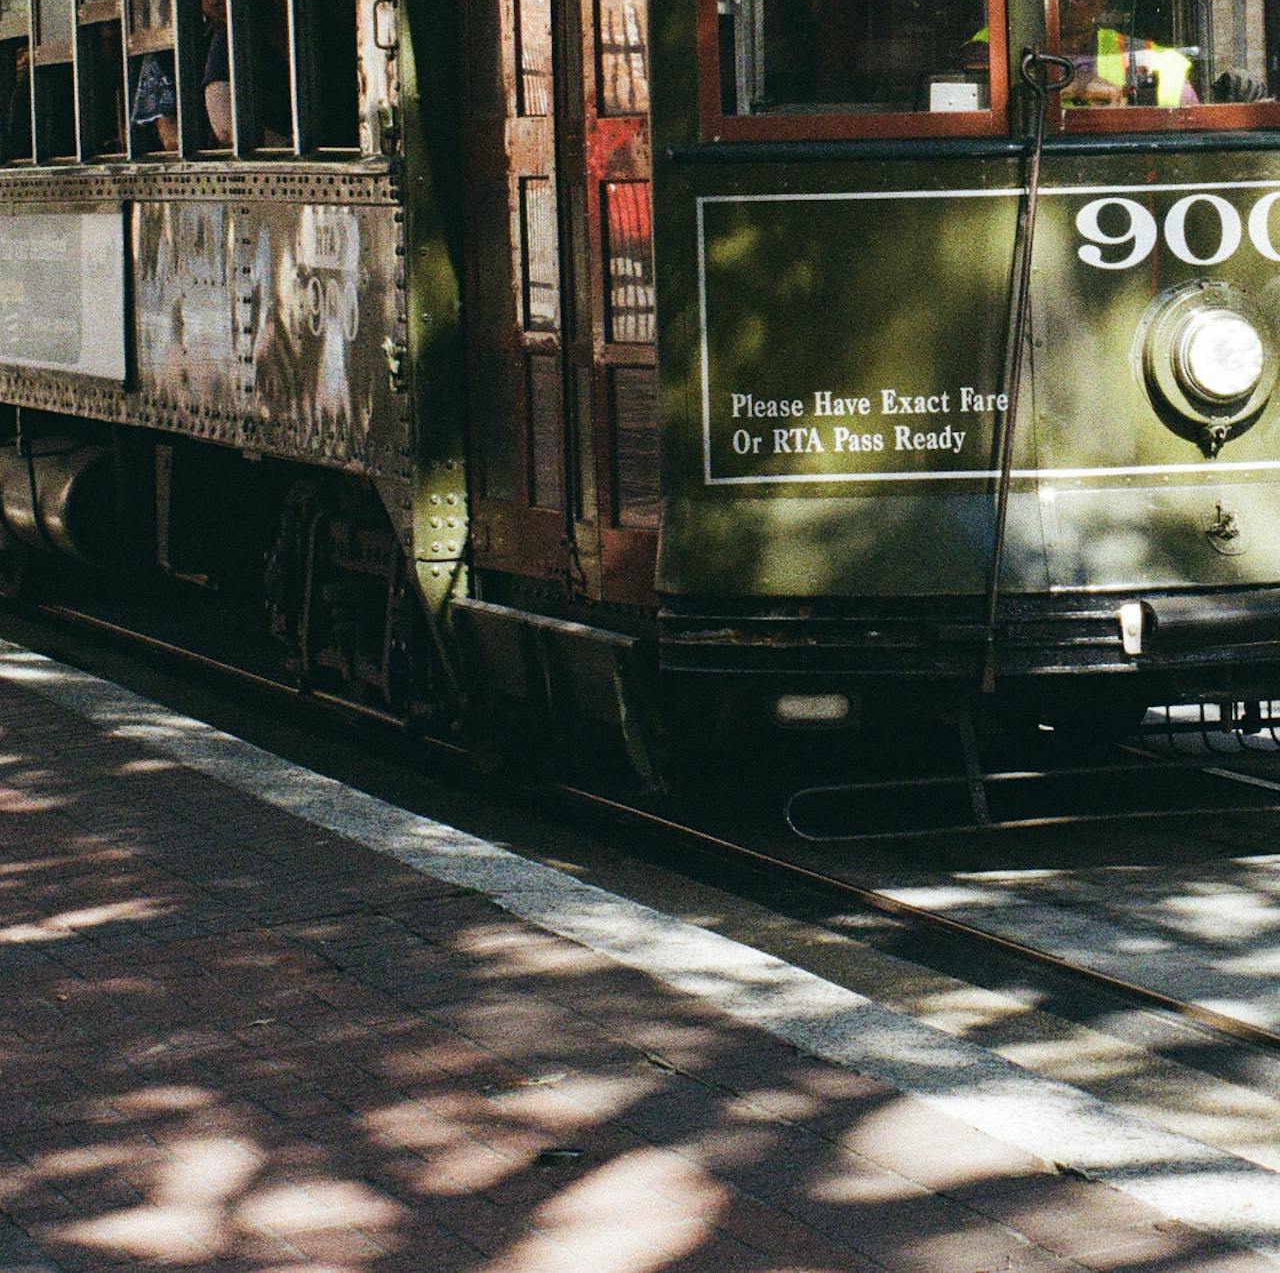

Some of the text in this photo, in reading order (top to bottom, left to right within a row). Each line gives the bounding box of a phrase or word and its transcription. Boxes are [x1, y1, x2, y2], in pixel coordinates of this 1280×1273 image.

[731, 386, 1009, 418] Please Have Exact Fare
[733, 424, 966, 454] Or RTA Pass Ready
